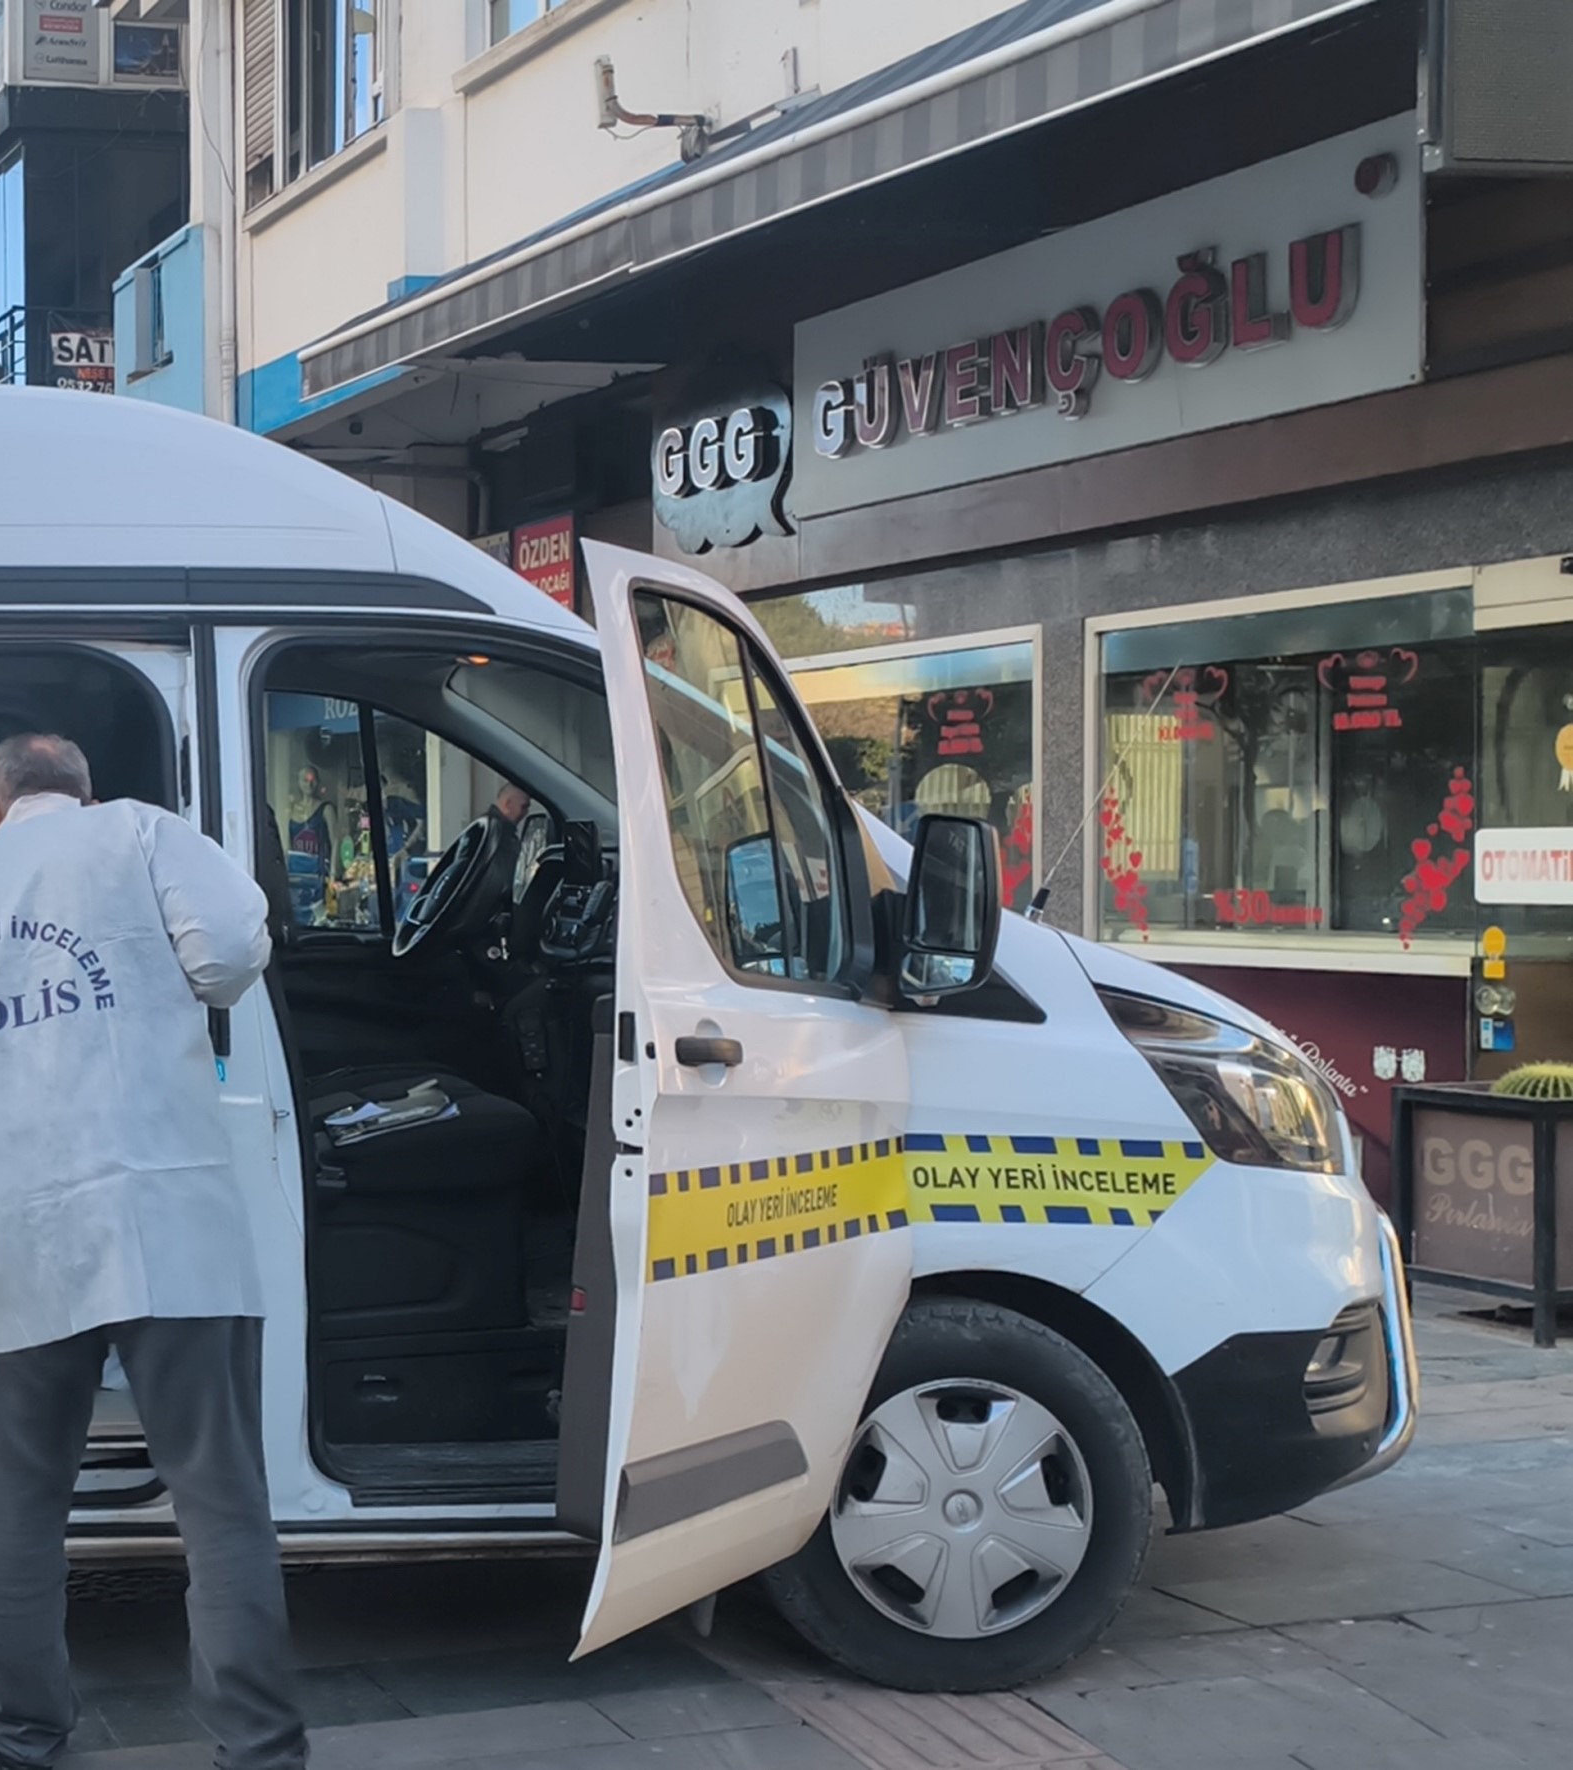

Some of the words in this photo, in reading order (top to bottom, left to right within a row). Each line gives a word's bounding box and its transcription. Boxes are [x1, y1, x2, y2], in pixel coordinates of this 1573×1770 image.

[811, 222, 1361, 460] GÜVENÇOĞLU
[656, 406, 769, 498] GGG
[519, 530, 570, 571] ÖZDEN
[912, 1165, 981, 1189] OLAY
[987, 1164, 1047, 1190] YERİ
[1053, 1164, 1177, 1195] İNCELEME
[1423, 1137, 1533, 1195] GGG
[727, 1198, 759, 1228] OLAY
